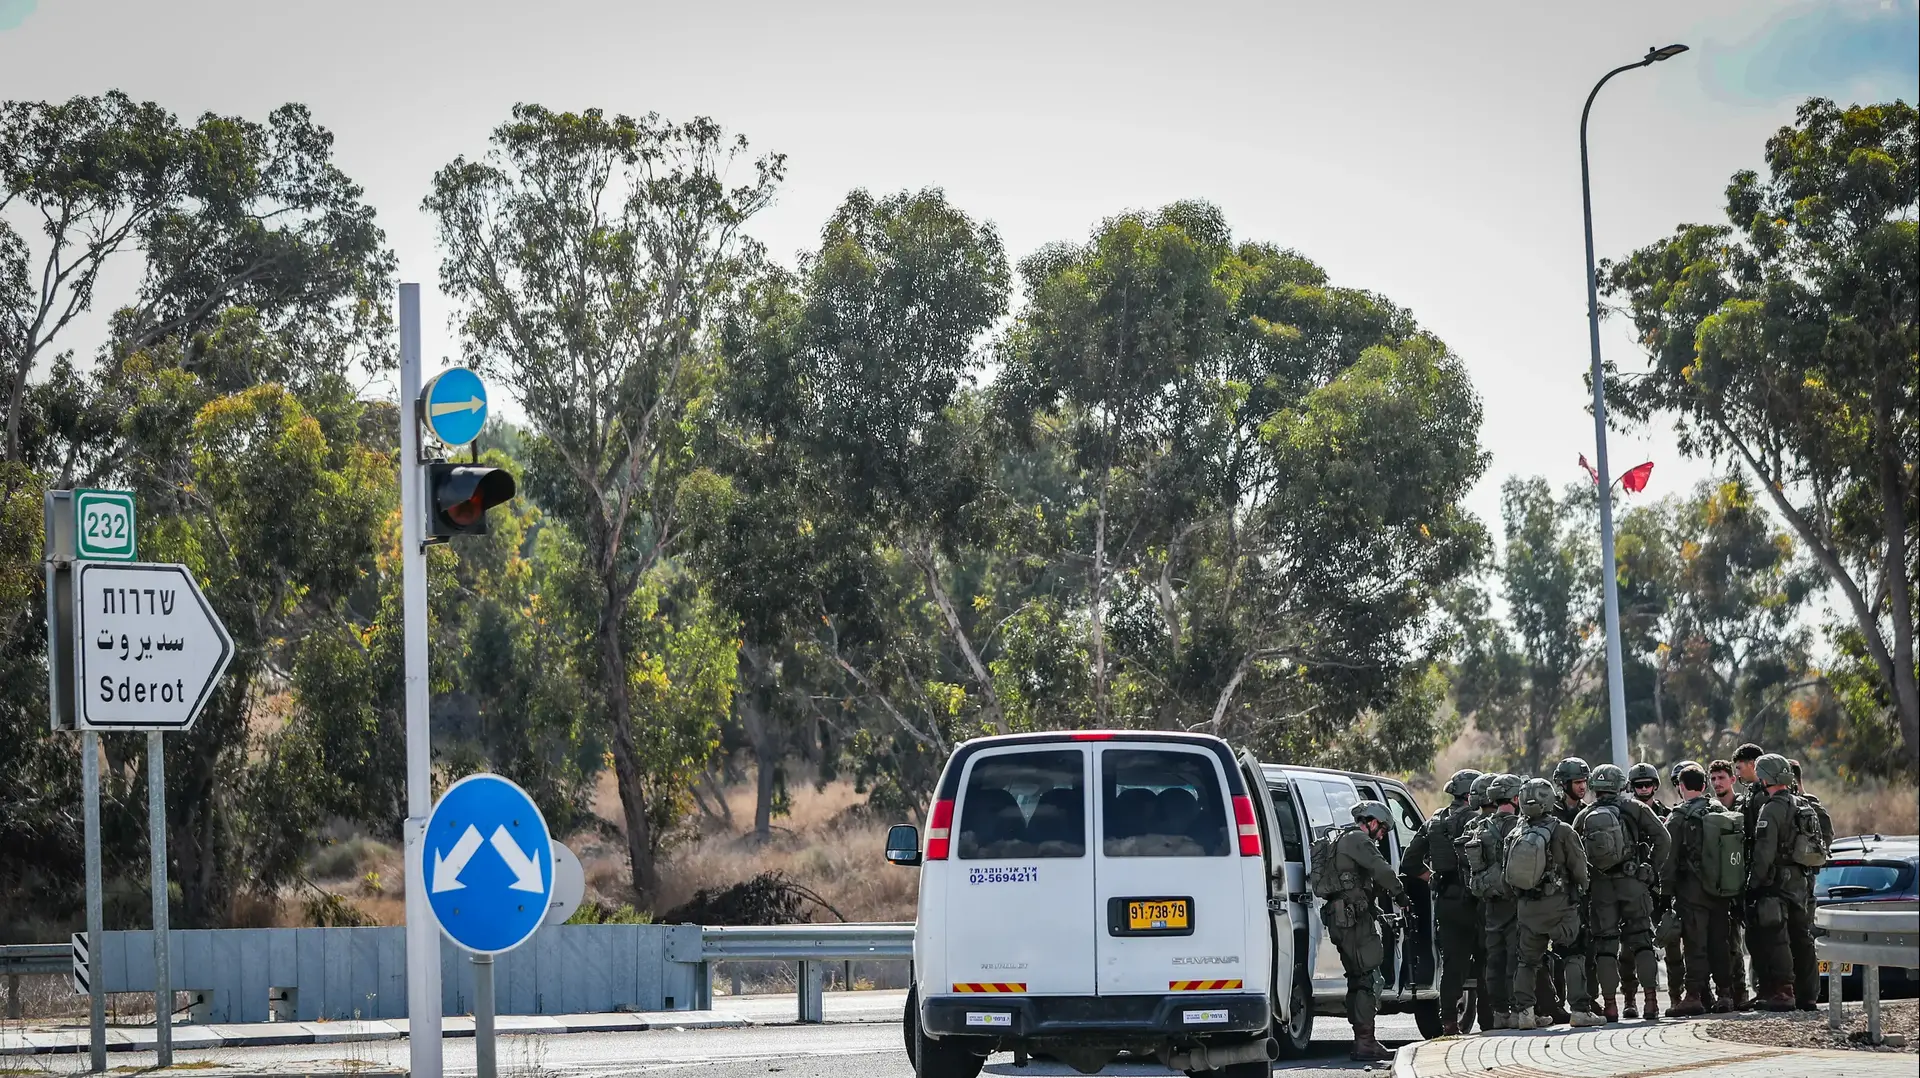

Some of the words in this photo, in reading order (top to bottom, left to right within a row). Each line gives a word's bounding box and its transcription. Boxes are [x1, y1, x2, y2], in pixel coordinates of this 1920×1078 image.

[87, 511, 126, 539] 232
[103, 588, 175, 615] שדרות
[97, 629, 184, 661] سديروت
[100, 675, 184, 703] Sderot
[1730, 851, 1741, 866] 60
[969, 873, 1037, 883] 02-5694211
[1131, 904, 1185, 919] 91-738-79
